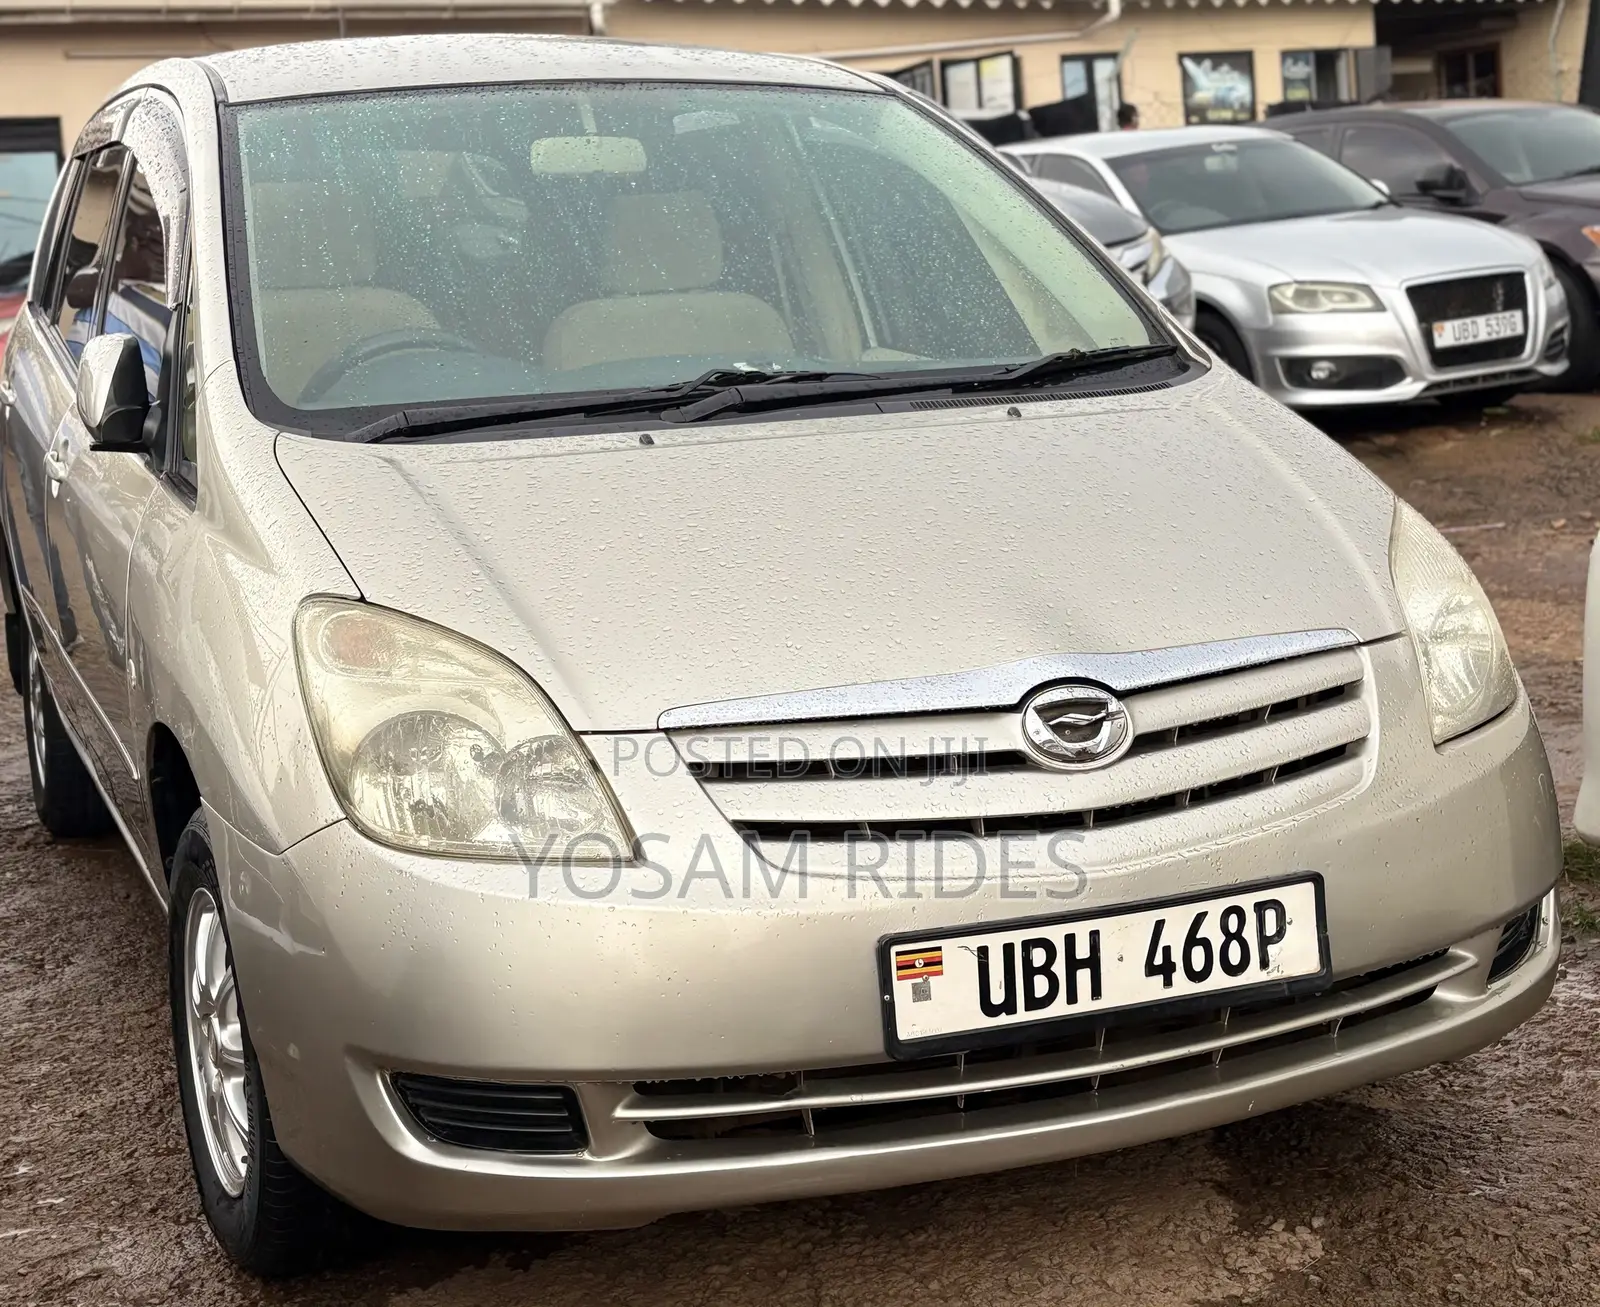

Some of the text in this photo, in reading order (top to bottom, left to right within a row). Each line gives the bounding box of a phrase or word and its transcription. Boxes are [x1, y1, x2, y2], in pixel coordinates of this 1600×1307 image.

[1452, 320, 1480, 341] UBD
[977, 898, 1286, 1019] UBH 468P
